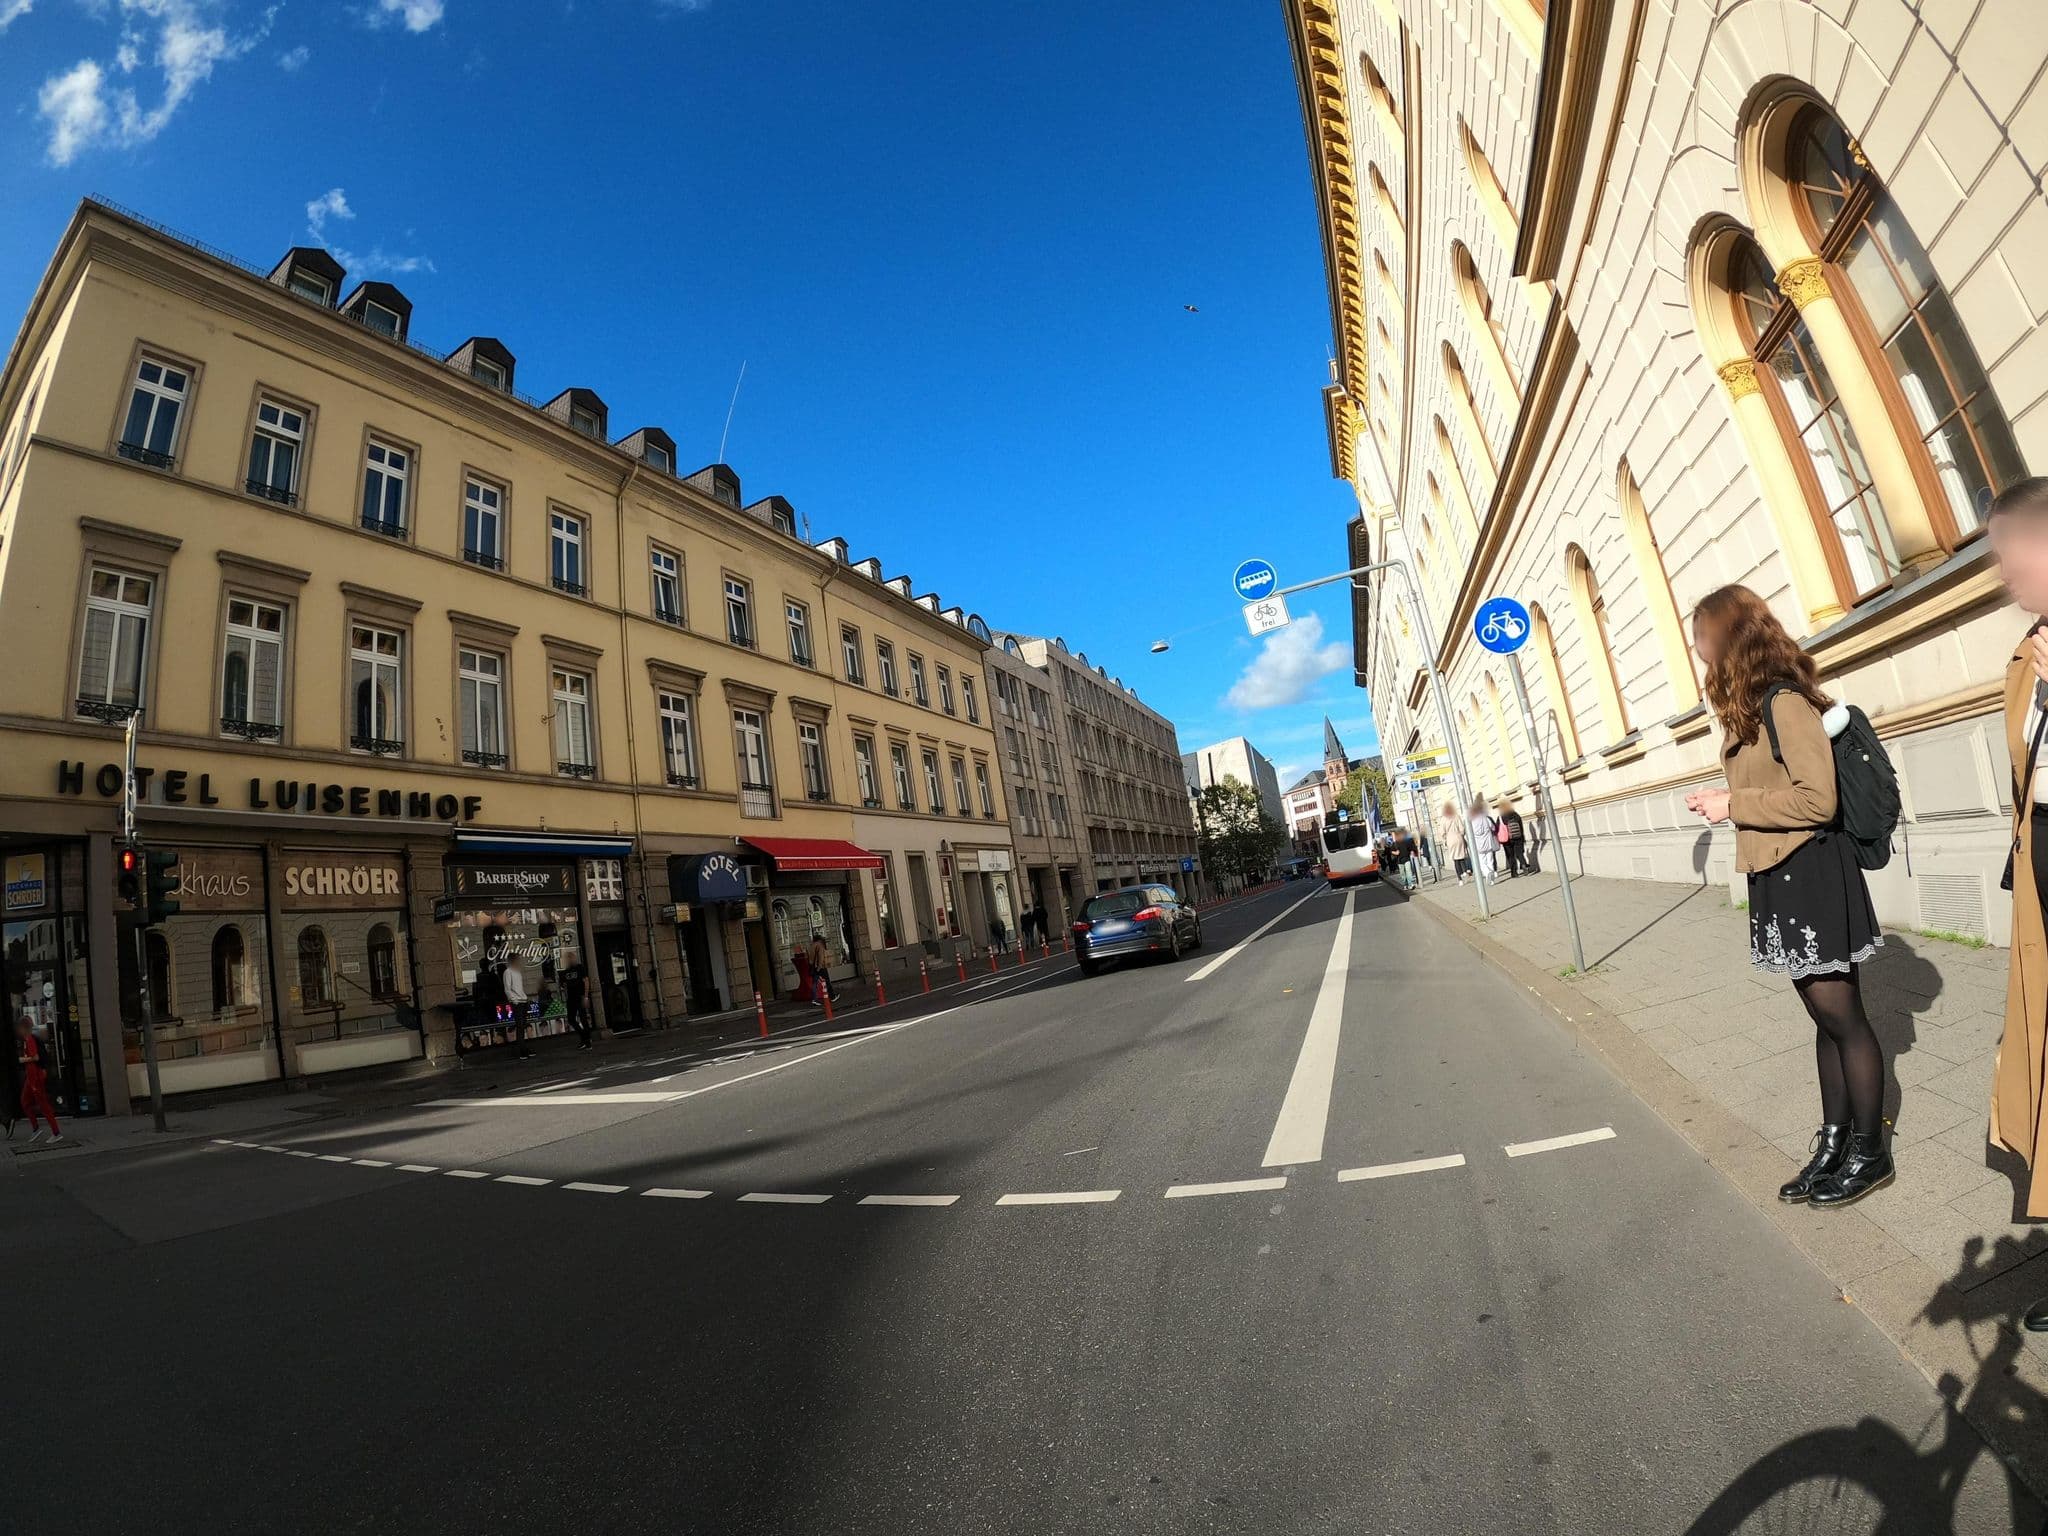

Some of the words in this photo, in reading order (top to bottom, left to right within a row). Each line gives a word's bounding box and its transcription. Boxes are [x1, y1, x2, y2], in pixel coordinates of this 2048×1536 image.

[1262, 618, 1276, 627] frei
[58, 760, 219, 804] HOTEL
[250, 778, 483, 820] LUISENHOF
[285, 865, 400, 896] SCHRÖER
[702, 855, 740, 882] HOTEL
